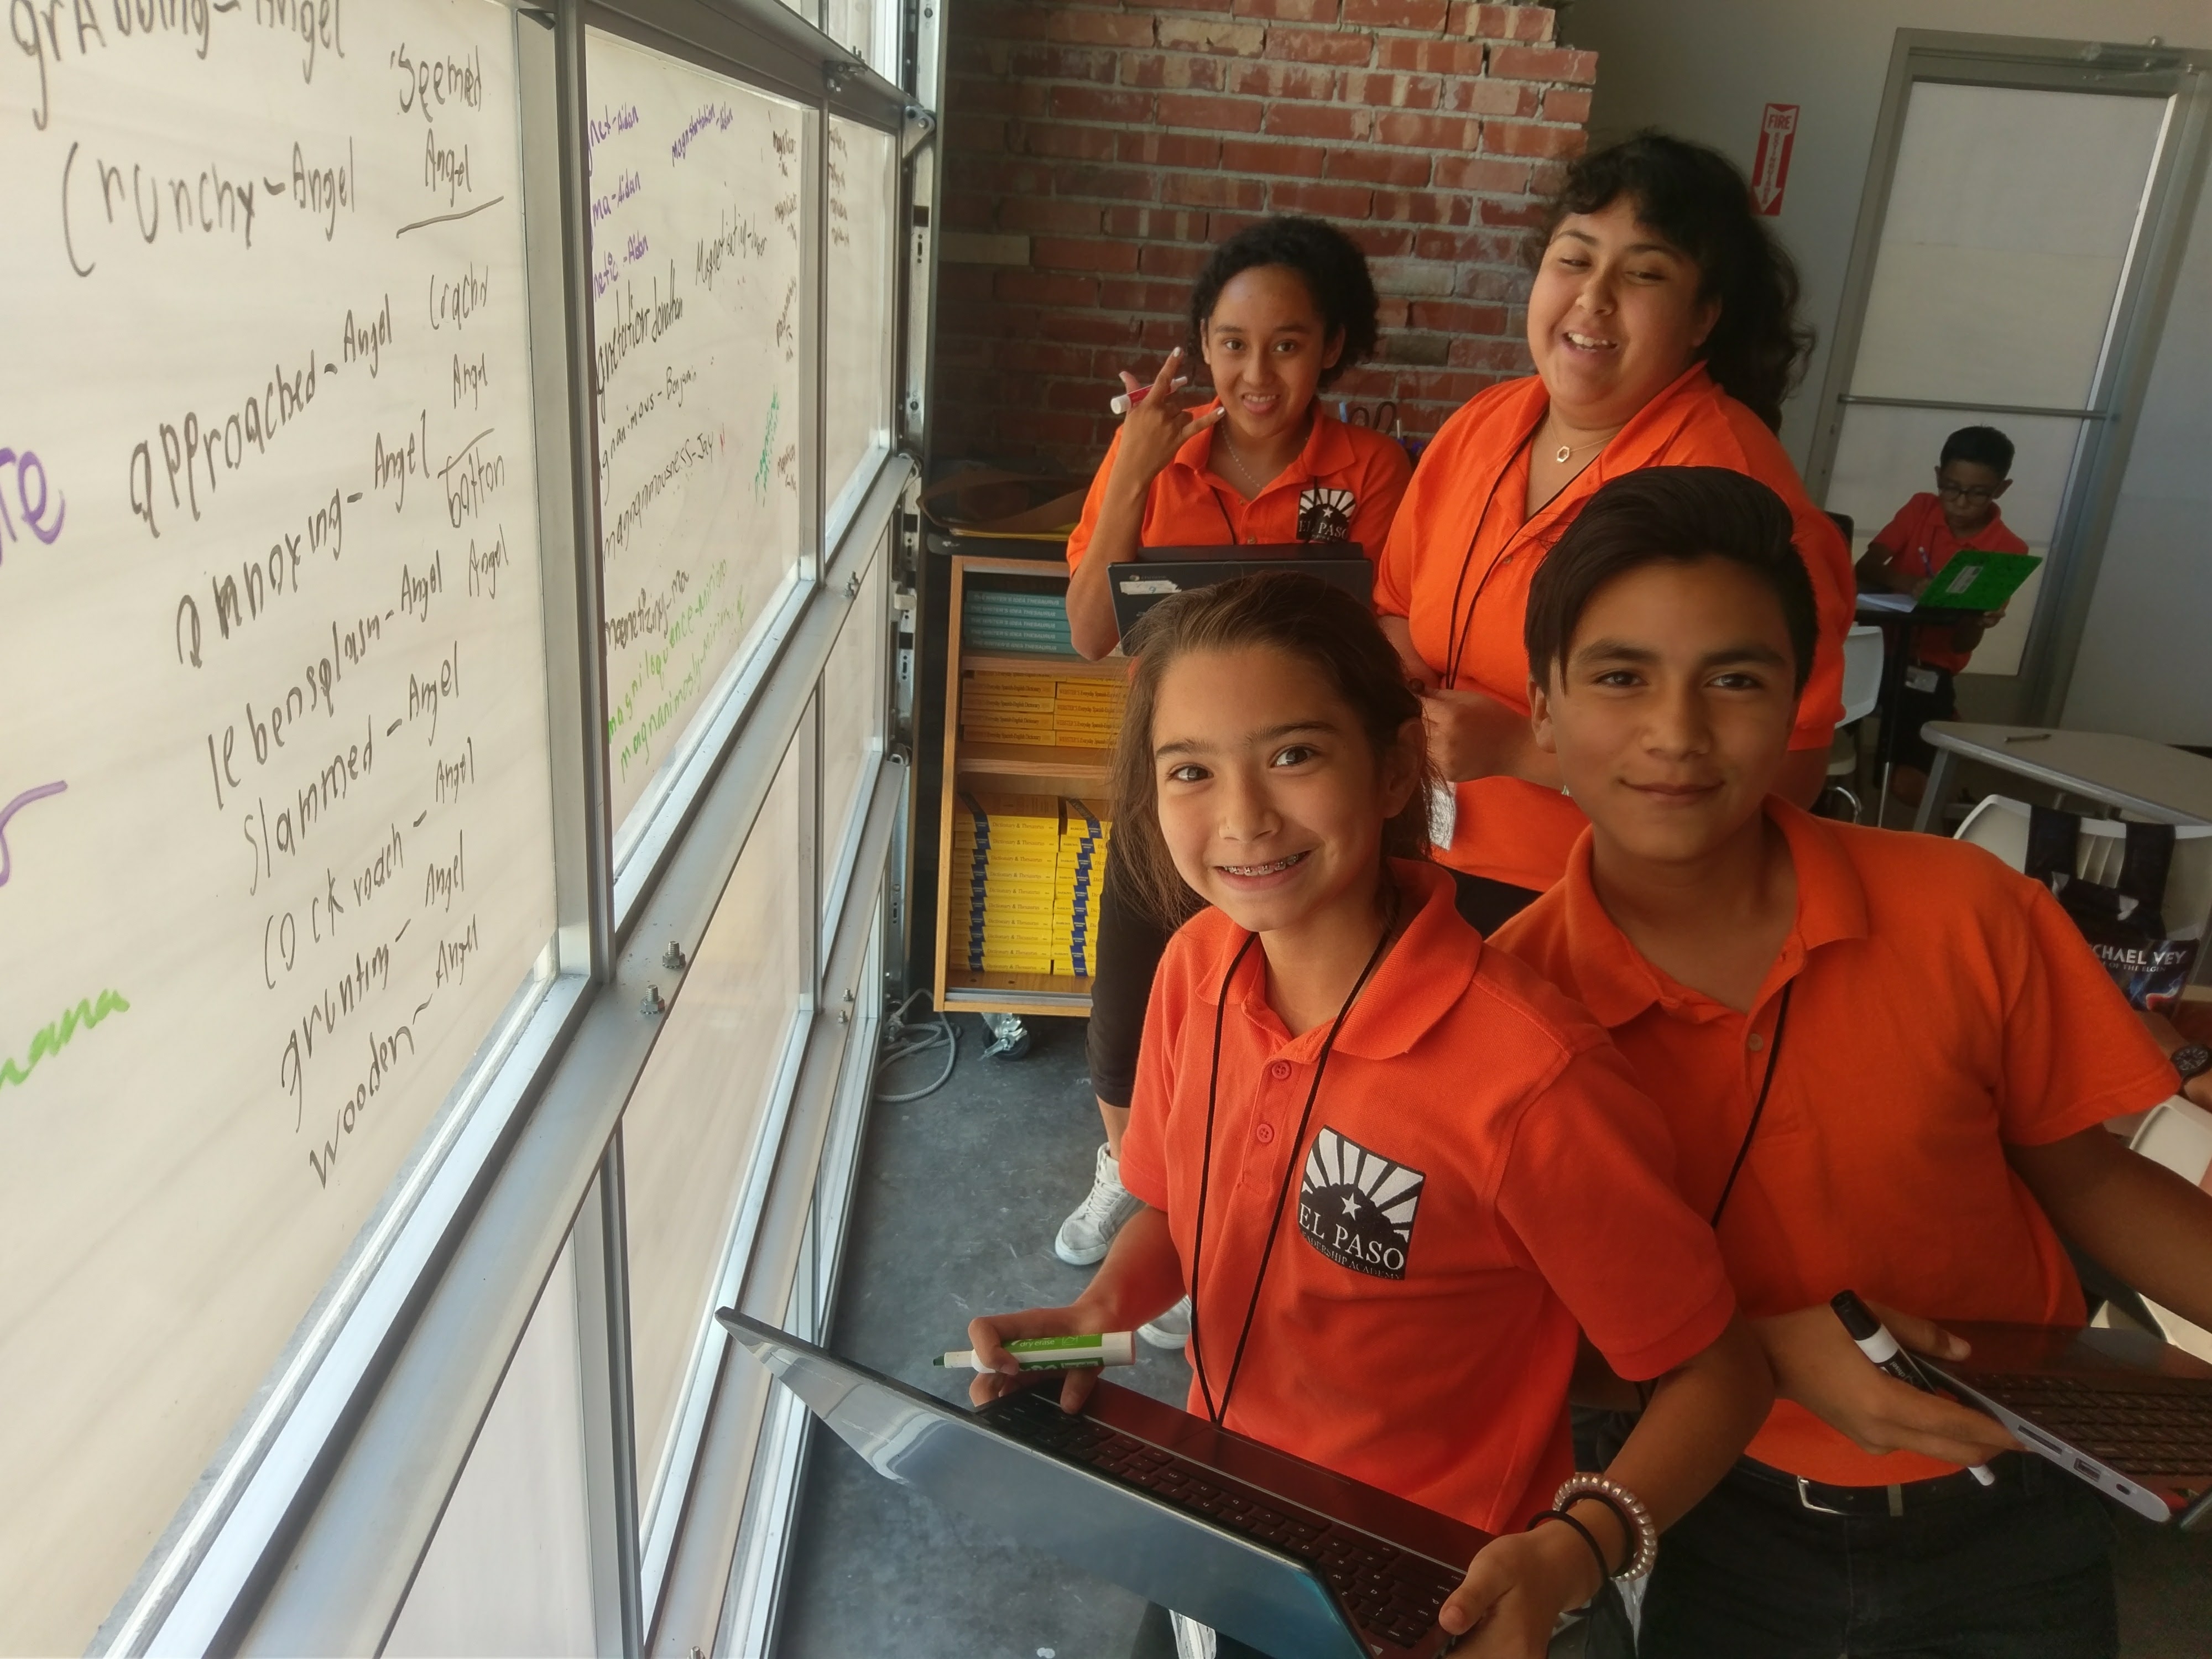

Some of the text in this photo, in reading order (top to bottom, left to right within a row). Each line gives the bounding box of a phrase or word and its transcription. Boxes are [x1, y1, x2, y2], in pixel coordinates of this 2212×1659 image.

[1768, 114, 1792, 130] FIRE
[425, 128, 472, 207] Angel
[468, 523, 509, 599] Angel
[2093, 944, 2186, 965] CHAEL VEY
[1299, 1202, 1405, 1270] EL PASO
[1302, 1230, 1348, 1265] EADERSHIP
[1890, 1361, 1906, 1377] chisel
